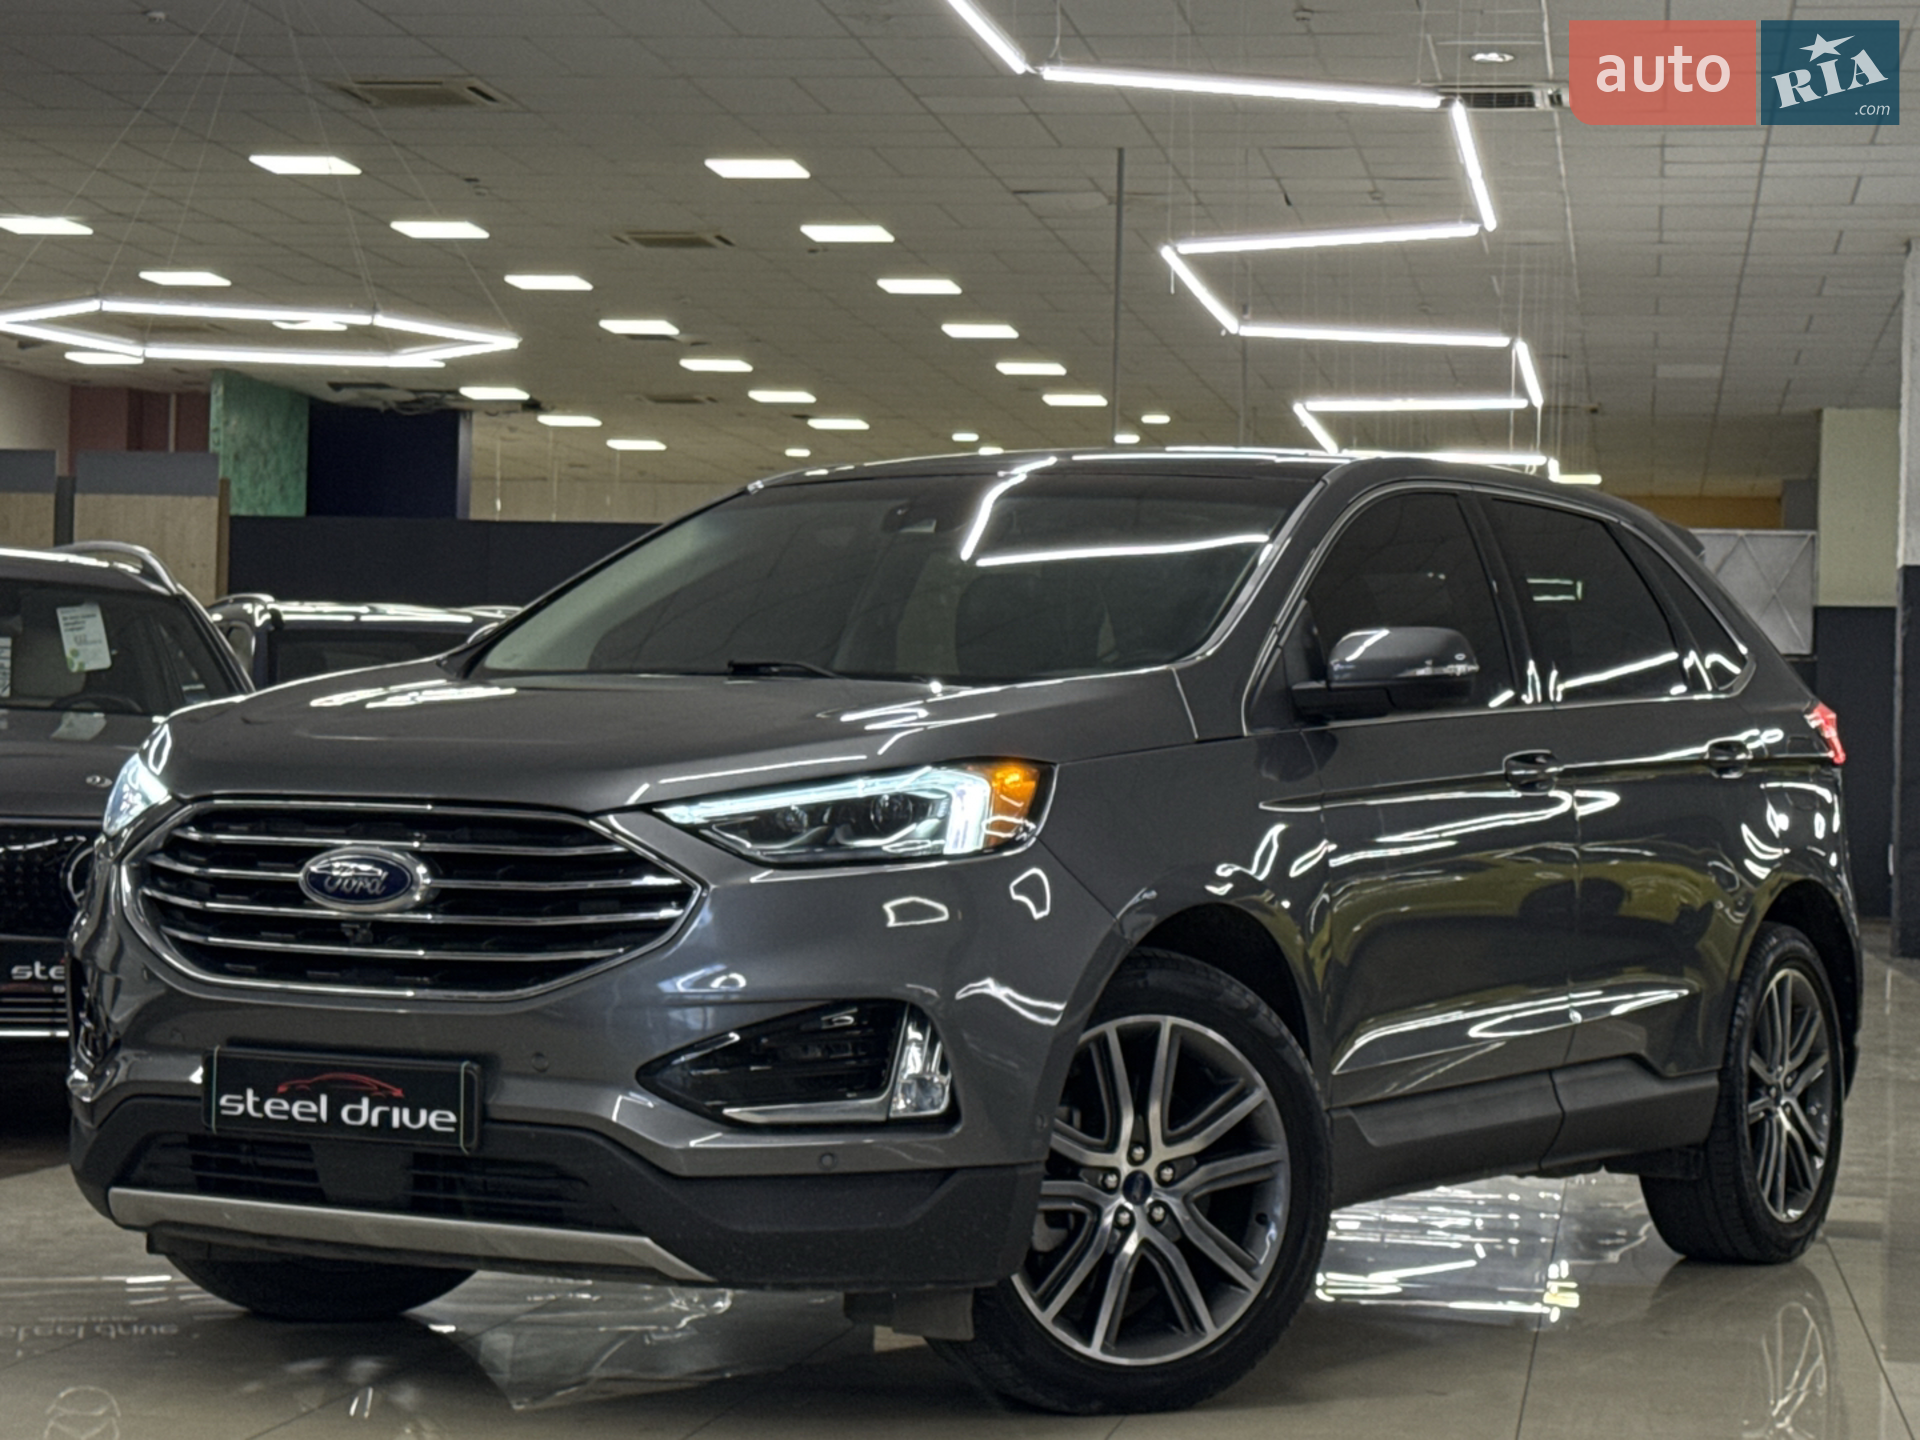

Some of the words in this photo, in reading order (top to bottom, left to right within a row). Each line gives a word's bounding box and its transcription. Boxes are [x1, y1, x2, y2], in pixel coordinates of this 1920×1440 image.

[322, 862, 389, 896] Ford
[219, 1087, 328, 1124] steel
[340, 1096, 458, 1133] drive
